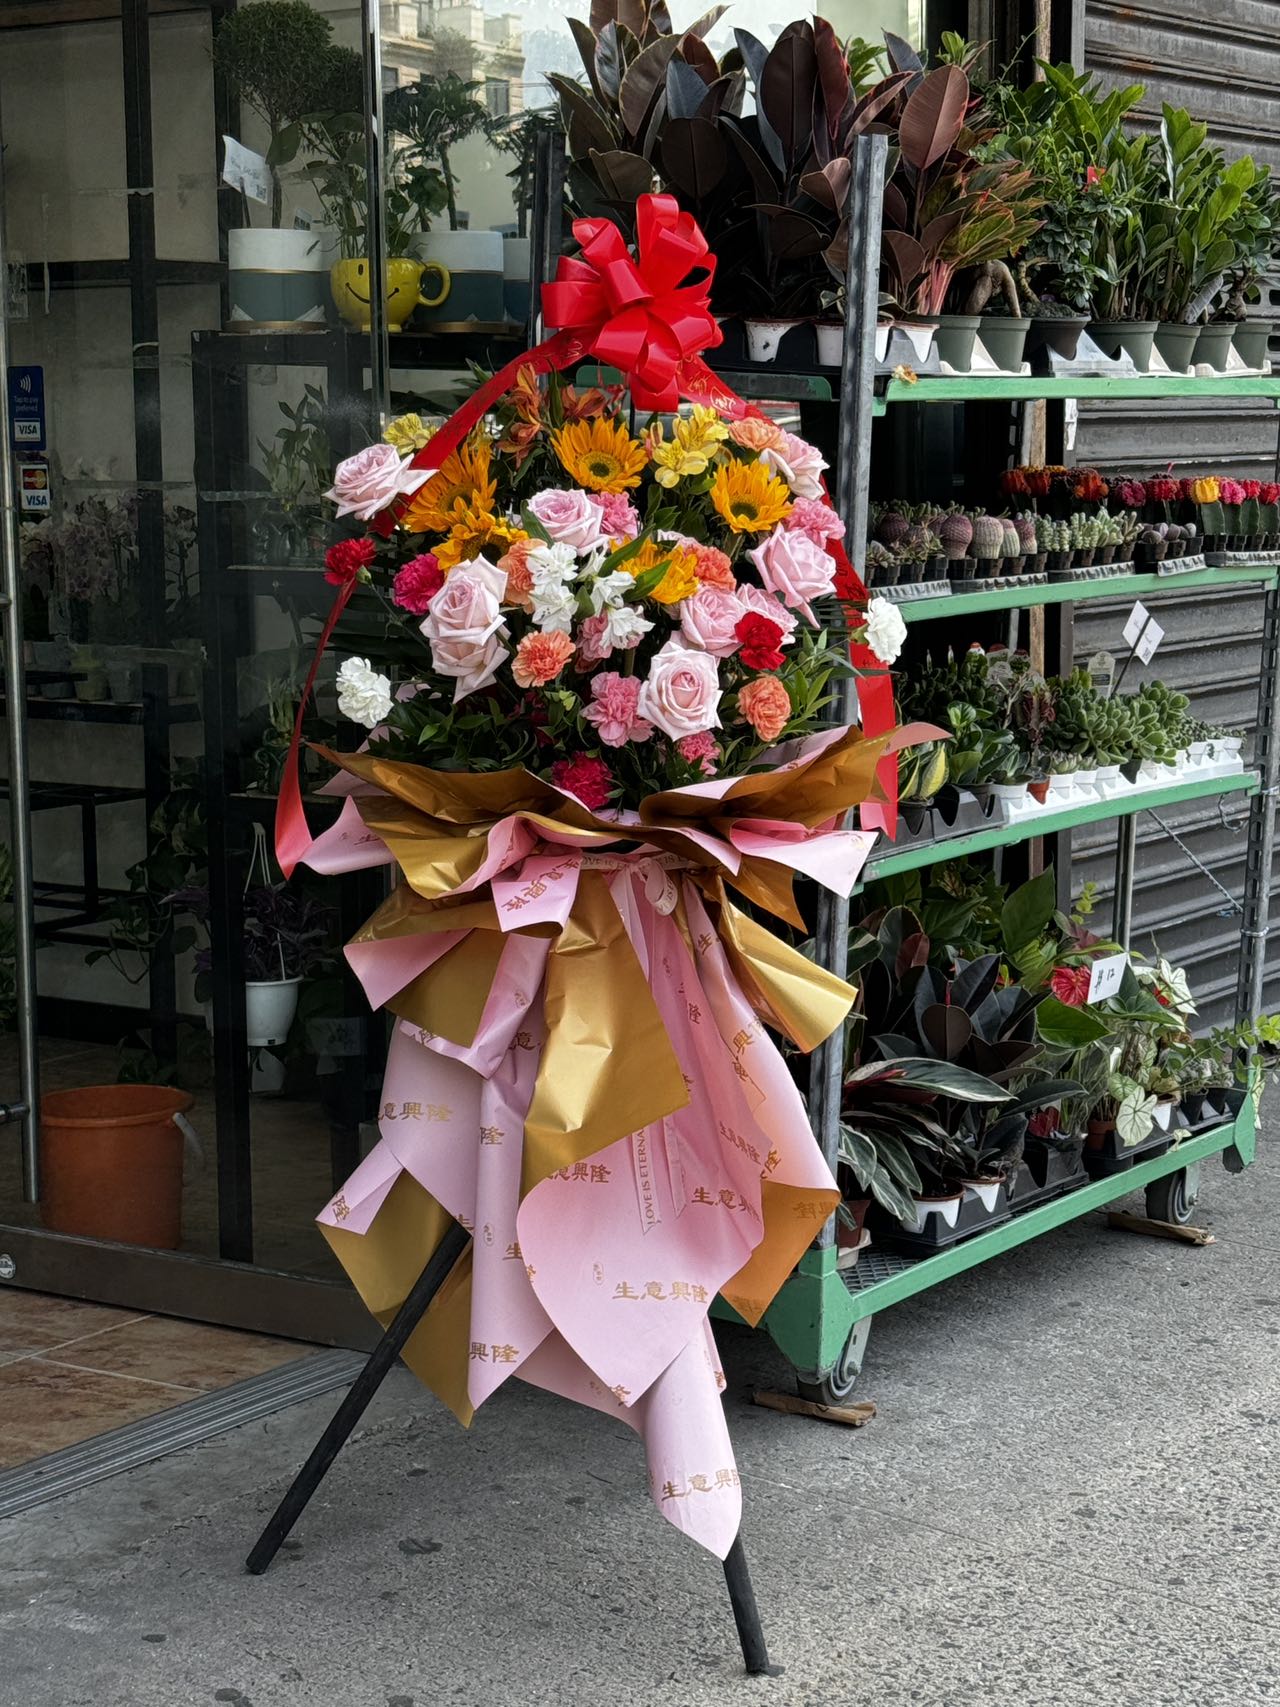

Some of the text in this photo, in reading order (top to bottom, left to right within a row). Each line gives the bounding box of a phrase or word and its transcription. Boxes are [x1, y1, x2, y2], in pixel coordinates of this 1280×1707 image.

[17, 424, 38, 435] VISA
[26, 495, 47, 506] VISA
[636, 1130, 649, 1178] ETERNA
[641, 1180, 651, 1191] IS
[612, 1280, 709, 1304] 生意興隆
